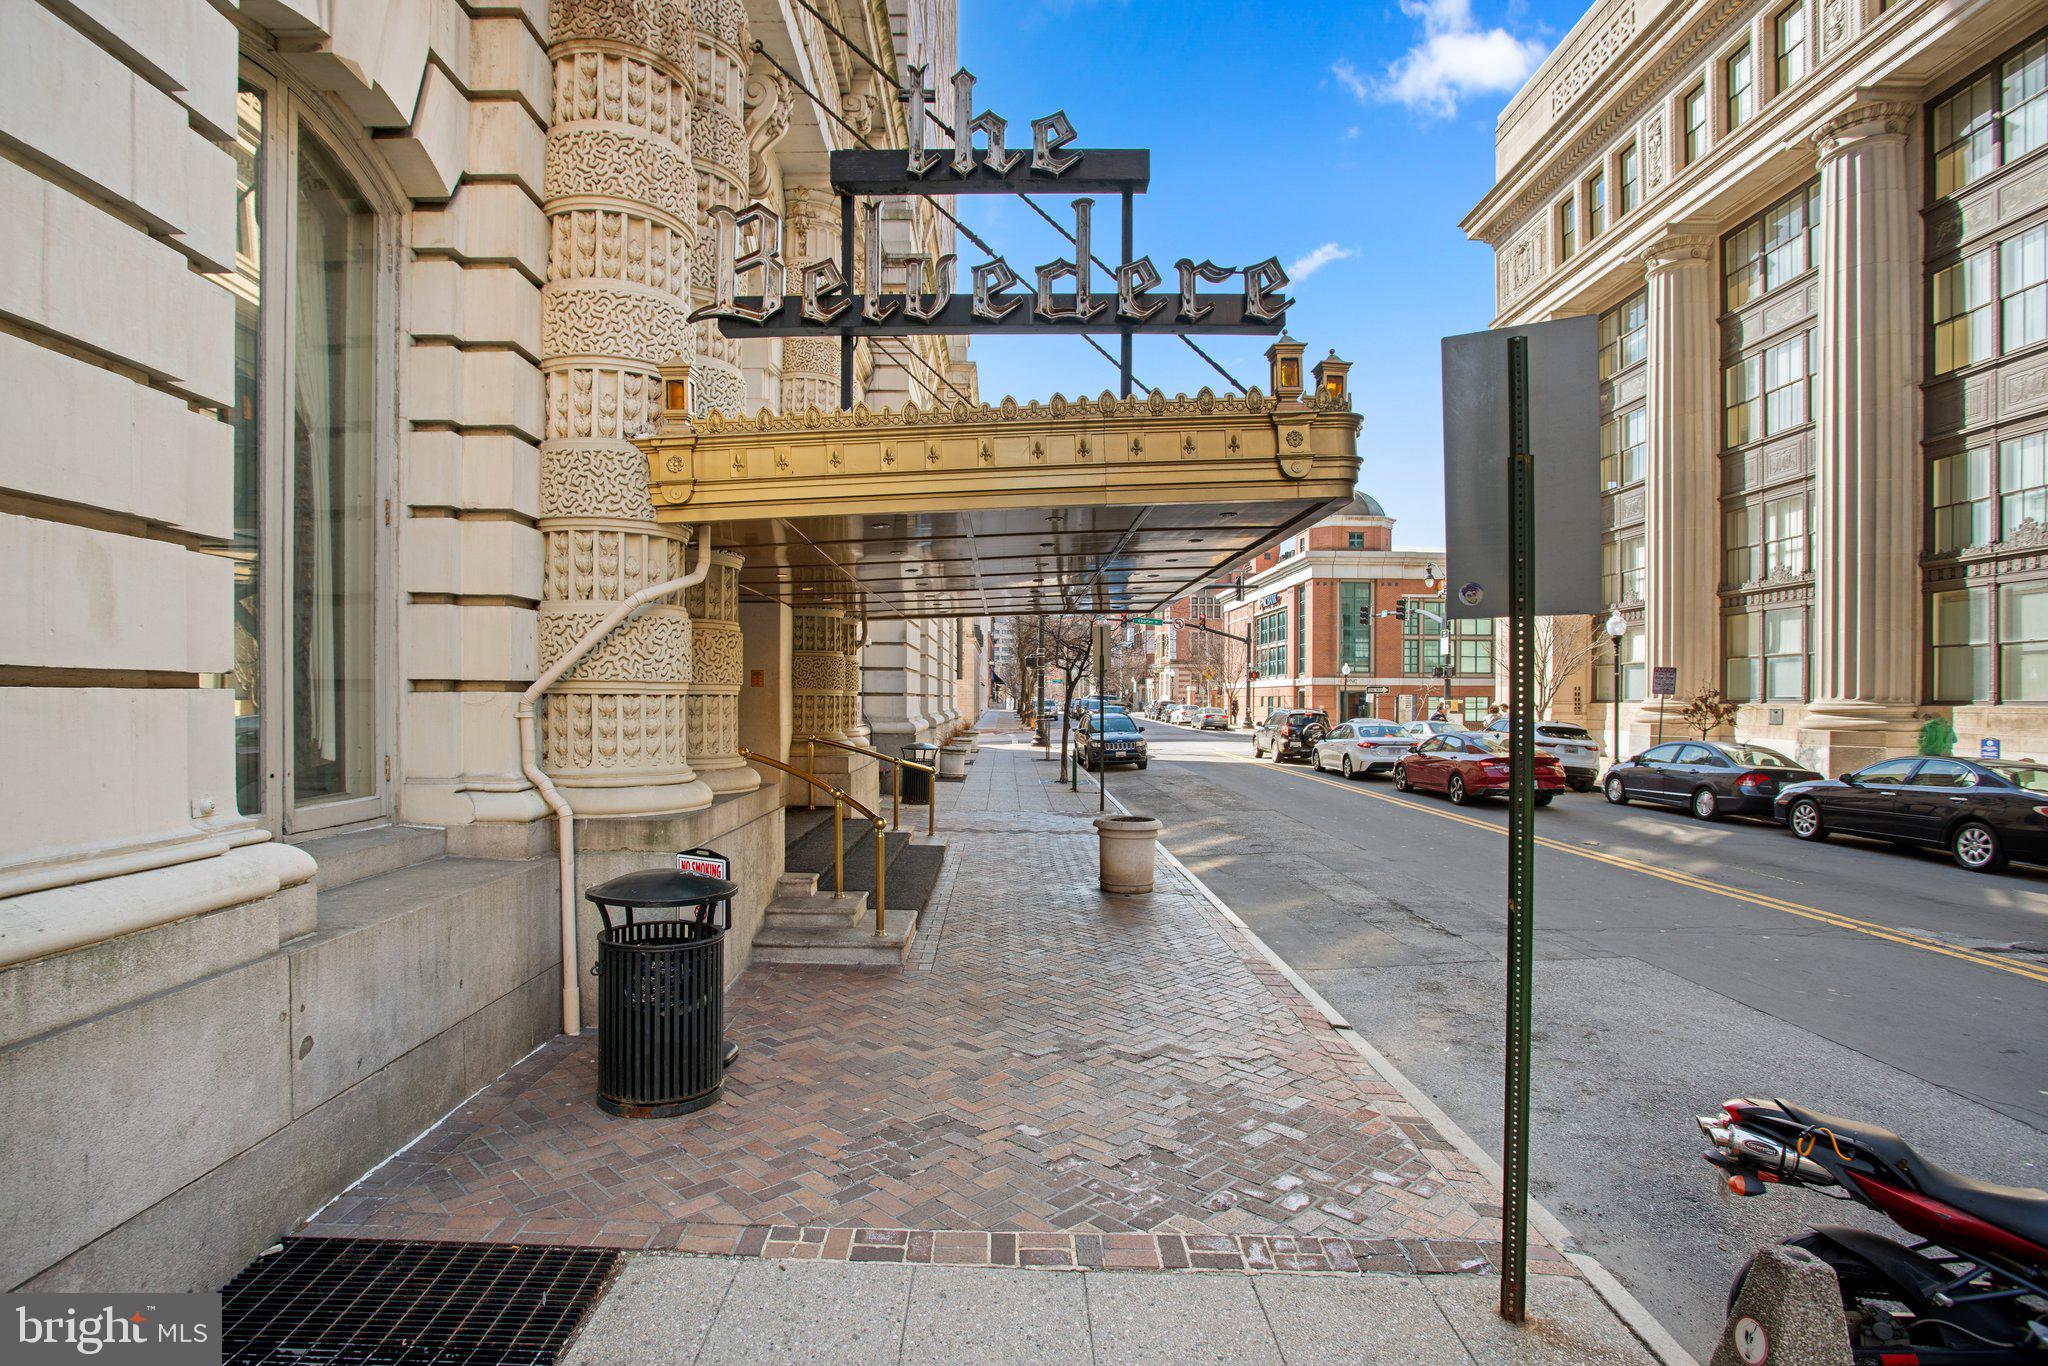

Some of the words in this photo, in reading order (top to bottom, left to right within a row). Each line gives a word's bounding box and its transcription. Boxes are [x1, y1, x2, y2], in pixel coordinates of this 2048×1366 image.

[900, 64, 1084, 180] the
[687, 197, 1295, 327] Belvedere
[681, 860, 690, 870] NO
[691, 861, 722, 879] SMOKING
